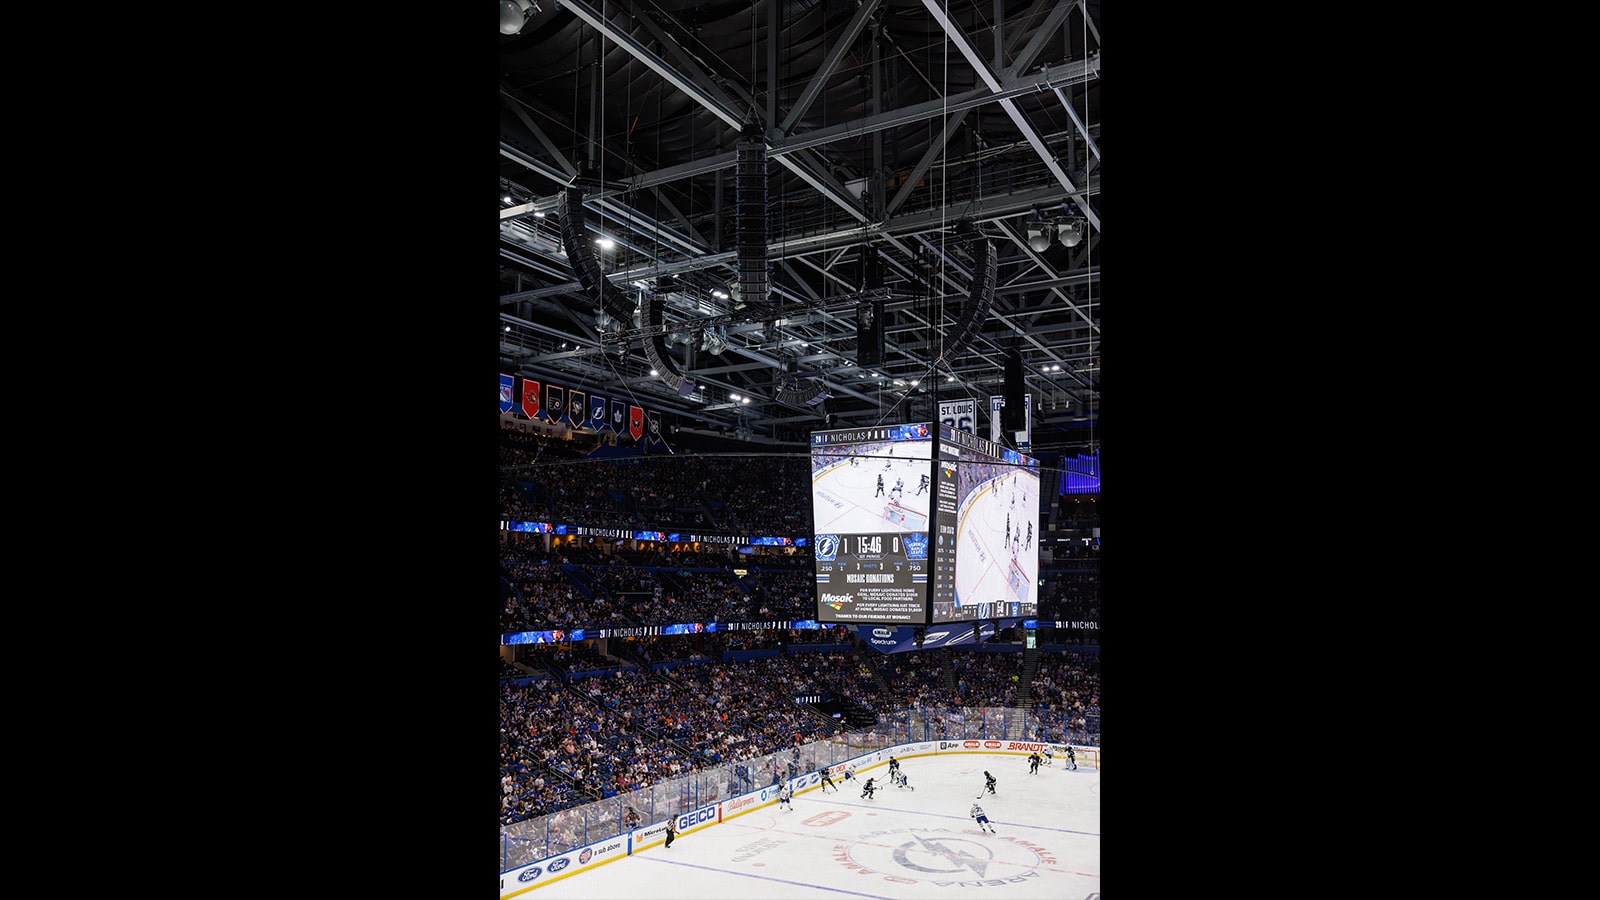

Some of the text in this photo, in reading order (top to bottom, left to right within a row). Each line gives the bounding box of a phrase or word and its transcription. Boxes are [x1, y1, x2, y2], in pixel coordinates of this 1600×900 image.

[941, 404, 973, 416] ST. LOUIS
[831, 431, 866, 442] NICHOLAS
[867, 429, 891, 439] PAUL
[589, 529, 616, 538] NICHOLAS
[616, 530, 633, 539] PAUL
[703, 535, 731, 544] NICHOLAS
[731, 537, 750, 545] PAUL
[857, 536, 881, 553] 15:46
[892, 536, 899, 553] 0
[843, 538, 848, 554] 1
[846, 573, 895, 583] MOSAIC DONATIONS
[820, 592, 854, 603] Mosaic
[741, 621, 771, 630] NICHOLAS
[772, 620, 792, 630] PAUL
[613, 627, 643, 638] NICHOLAS
[870, 637, 895, 646] Spectrum
[1007, 741, 1048, 752] BRANDT
[680, 806, 715, 830] GEICO
[598, 846, 607, 855] sub
[607, 842, 621, 852] above
[998, 835, 1057, 866] AMALIE
[551, 859, 567, 869] Ford
[832, 844, 876, 875] AMALIE
[521, 869, 539, 879] Ford
